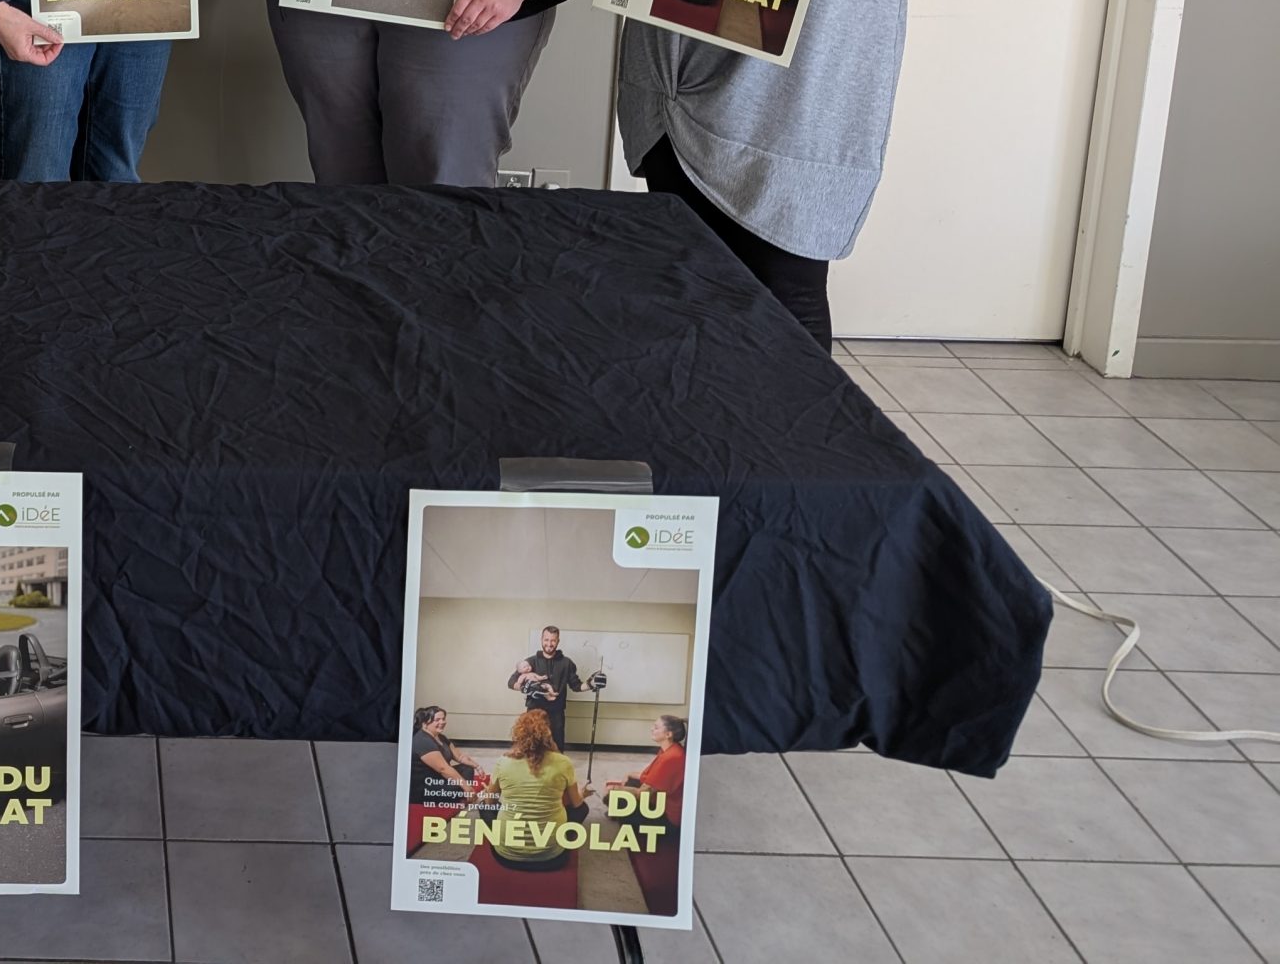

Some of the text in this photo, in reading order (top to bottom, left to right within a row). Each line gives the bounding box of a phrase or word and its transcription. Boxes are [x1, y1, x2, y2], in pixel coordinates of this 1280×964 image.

[22, 505, 61, 522] iDéE
[654, 527, 694, 544] iDéE
[424, 777, 444, 786] Que
[447, 778, 463, 786] fait
[424, 788, 500, 799] hockeyeur dans
[608, 790, 666, 819] DU
[422, 811, 666, 853] BÉNÉVOLAT
